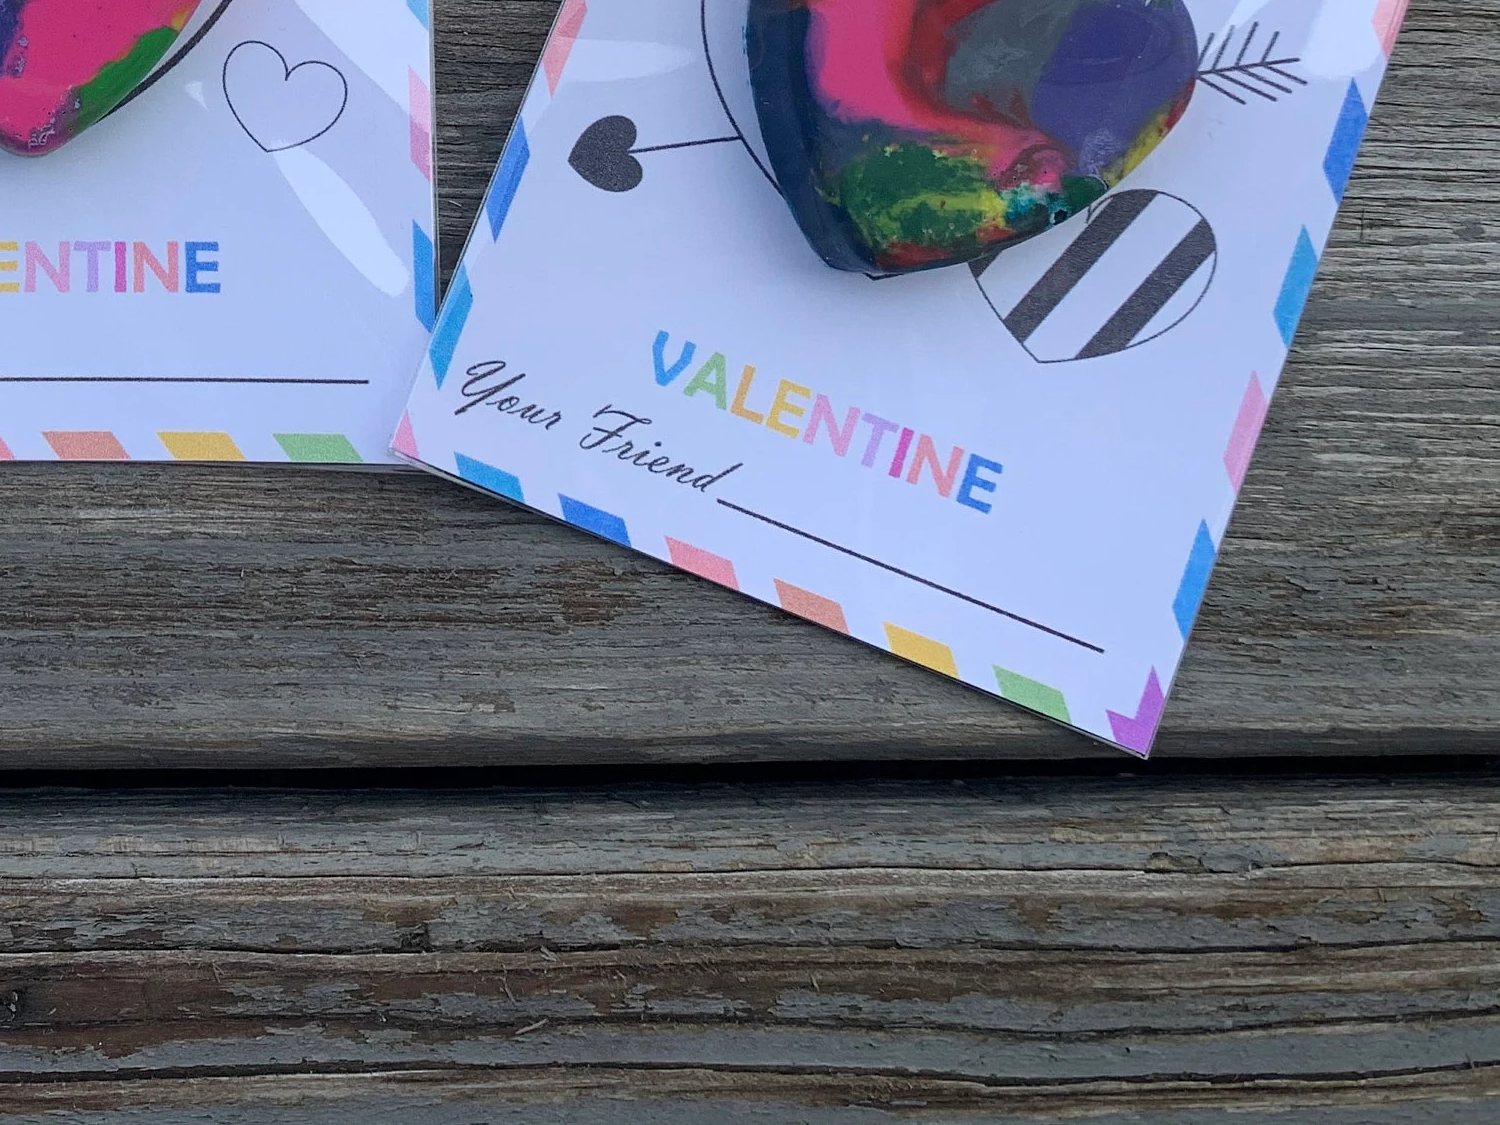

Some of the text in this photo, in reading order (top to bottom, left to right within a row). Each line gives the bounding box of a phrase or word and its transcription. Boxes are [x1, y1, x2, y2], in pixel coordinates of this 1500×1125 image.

[454, 360, 743, 493] Your Friend
[652, 330, 1004, 514] VALENTINE
